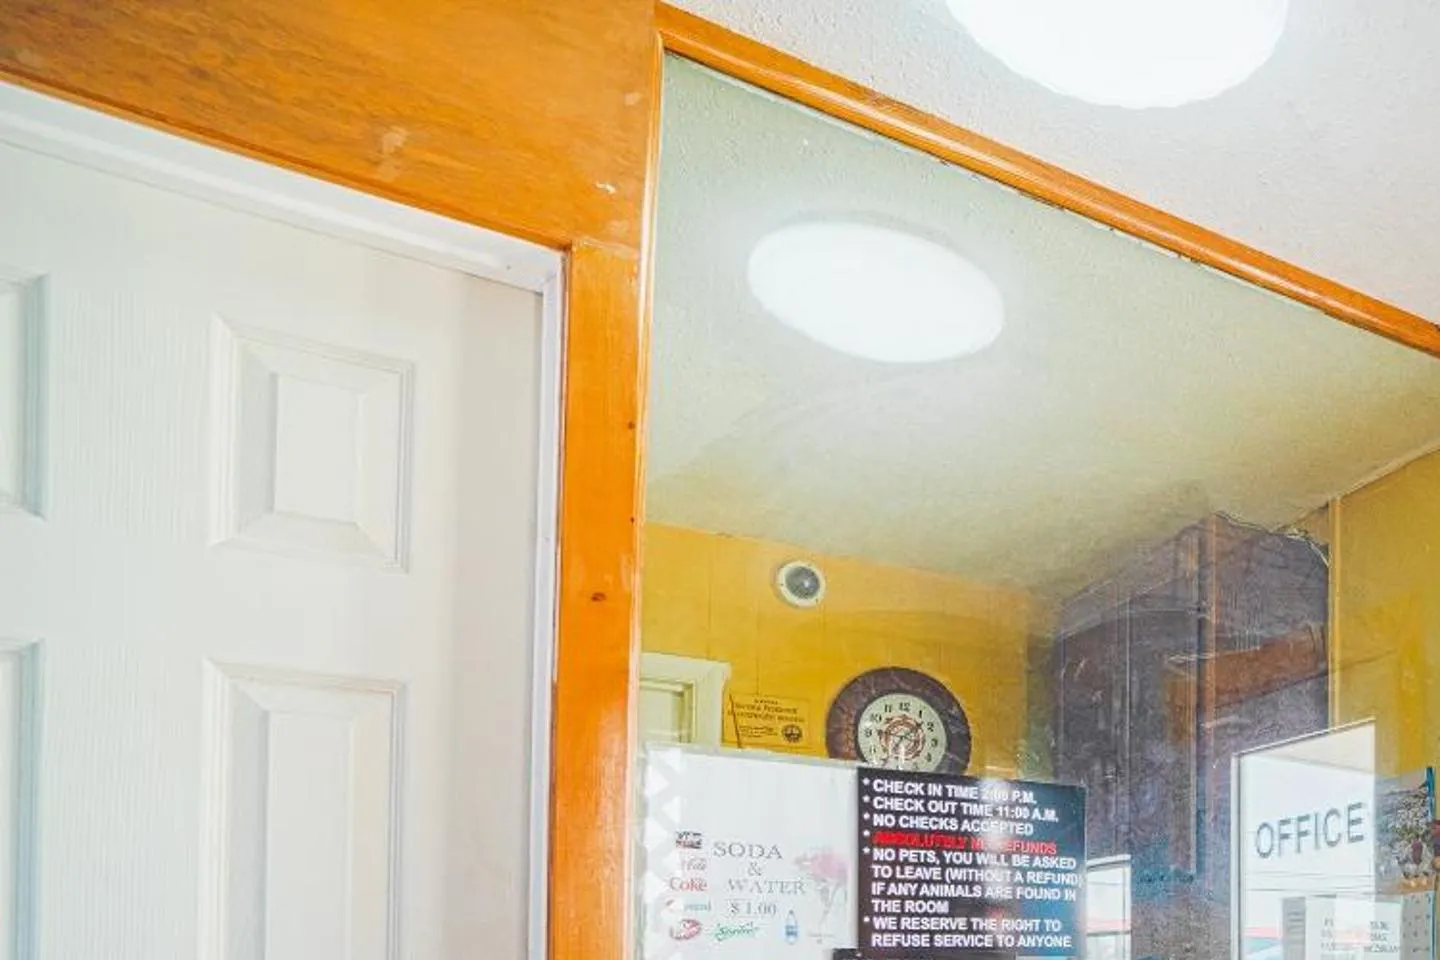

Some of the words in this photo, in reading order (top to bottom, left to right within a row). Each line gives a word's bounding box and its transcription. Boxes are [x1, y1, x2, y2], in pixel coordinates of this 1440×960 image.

[873, 779, 925, 795] CHECK
[928, 783, 943, 796] IN
[946, 785, 978, 800] TIME
[1012, 790, 1037, 804] P.M.
[873, 797, 925, 812] CHECK
[928, 800, 958, 815] OUT
[960, 802, 993, 817] TIME
[996, 805, 1030, 819] 11:00
[1032, 808, 1059, 823] A.M.
[873, 814, 896, 827] NO
[898, 815, 958, 831] CHECKS
[961, 818, 1034, 836] ACCEPTED
[1255, 802, 1365, 858] OFFICE
[713, 841, 784, 860] SODA
[873, 848, 896, 861] NO
[899, 849, 940, 864] PETS,
[943, 851, 972, 865] YOU
[975, 853, 1009, 867] WILL
[1011, 854, 1030, 867] BE
[1032, 856, 1076, 870] ASKED
[871, 865, 893, 878] TO
[896, 866, 942, 880] LEAVE
[945, 868, 1012, 884] (WITHOUT
[1014, 870, 1025, 882] A
[669, 877, 708, 892] Coke
[728, 878, 806, 895] WATER
[871, 882, 886, 895] IF
[886, 883, 918, 896] ANY
[919, 884, 982, 898] ANIMALS
[984, 886, 1012, 899] ARE
[1016, 887, 1060, 900] FOUND
[1064, 889, 1077, 901] IN
[871, 900, 901, 912] THE
[904, 900, 949, 913] ROOM
[873, 917, 897, 930] WE
[901, 918, 969, 931] RESERVE
[971, 918, 997, 931] THE
[1001, 919, 1042, 932] RIGHT
[1044, 919, 1062, 931] TO
[871, 934, 930, 948] REFUSE
[933, 934, 994, 948] SERVICE
[997, 934, 1015, 948] TO
[1017, 935, 1073, 948] ANYONE
